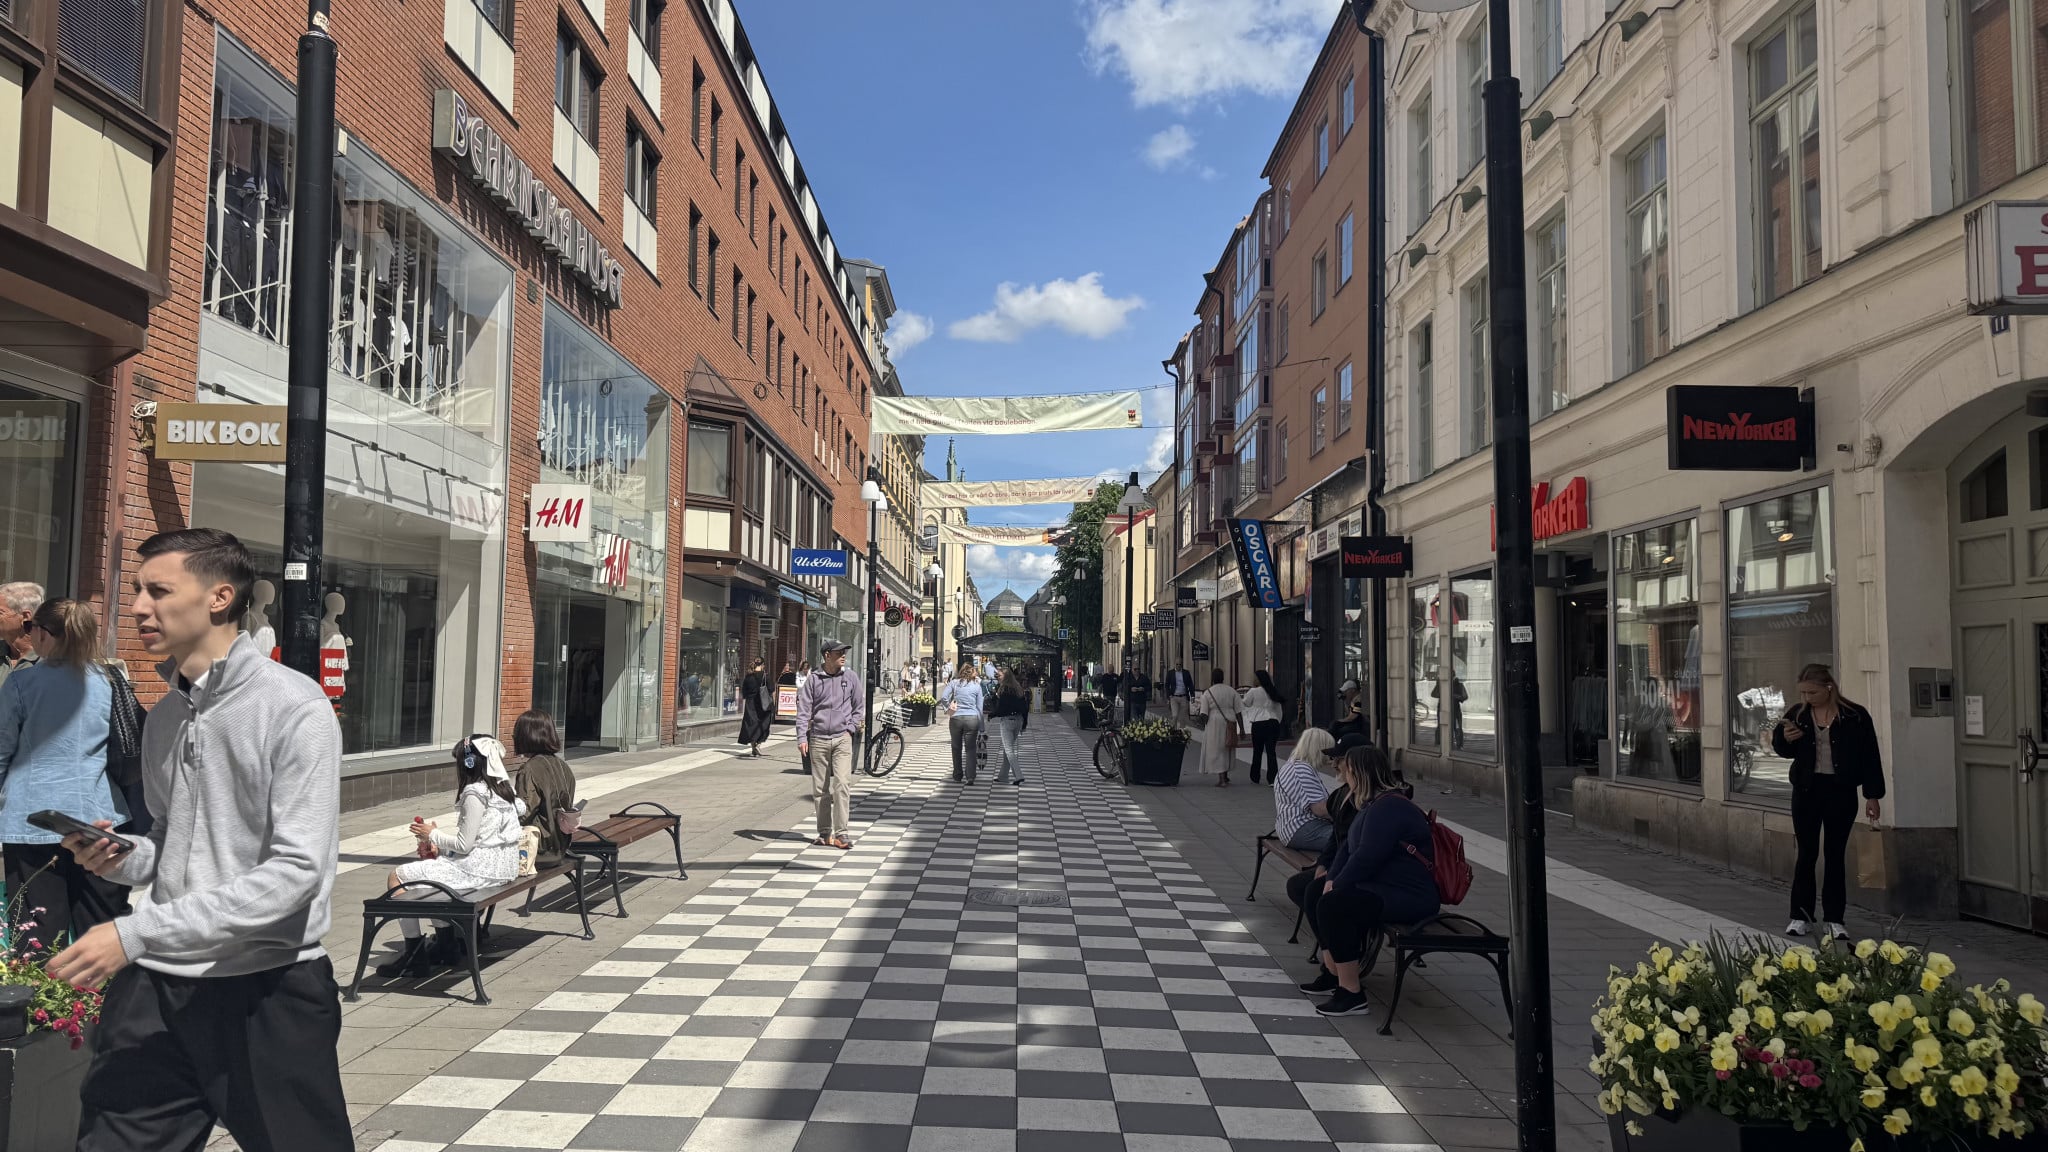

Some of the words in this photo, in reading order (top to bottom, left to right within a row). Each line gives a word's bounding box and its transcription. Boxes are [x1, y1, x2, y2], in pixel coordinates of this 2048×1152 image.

[167, 420, 216, 444] BIK
[218, 421, 282, 446] BOK
[536, 497, 584, 529] H&M
[794, 556, 844, 568] Ur&Penn
[1234, 527, 1257, 597] GALLERIA
[1244, 523, 1272, 590] OSCAR
